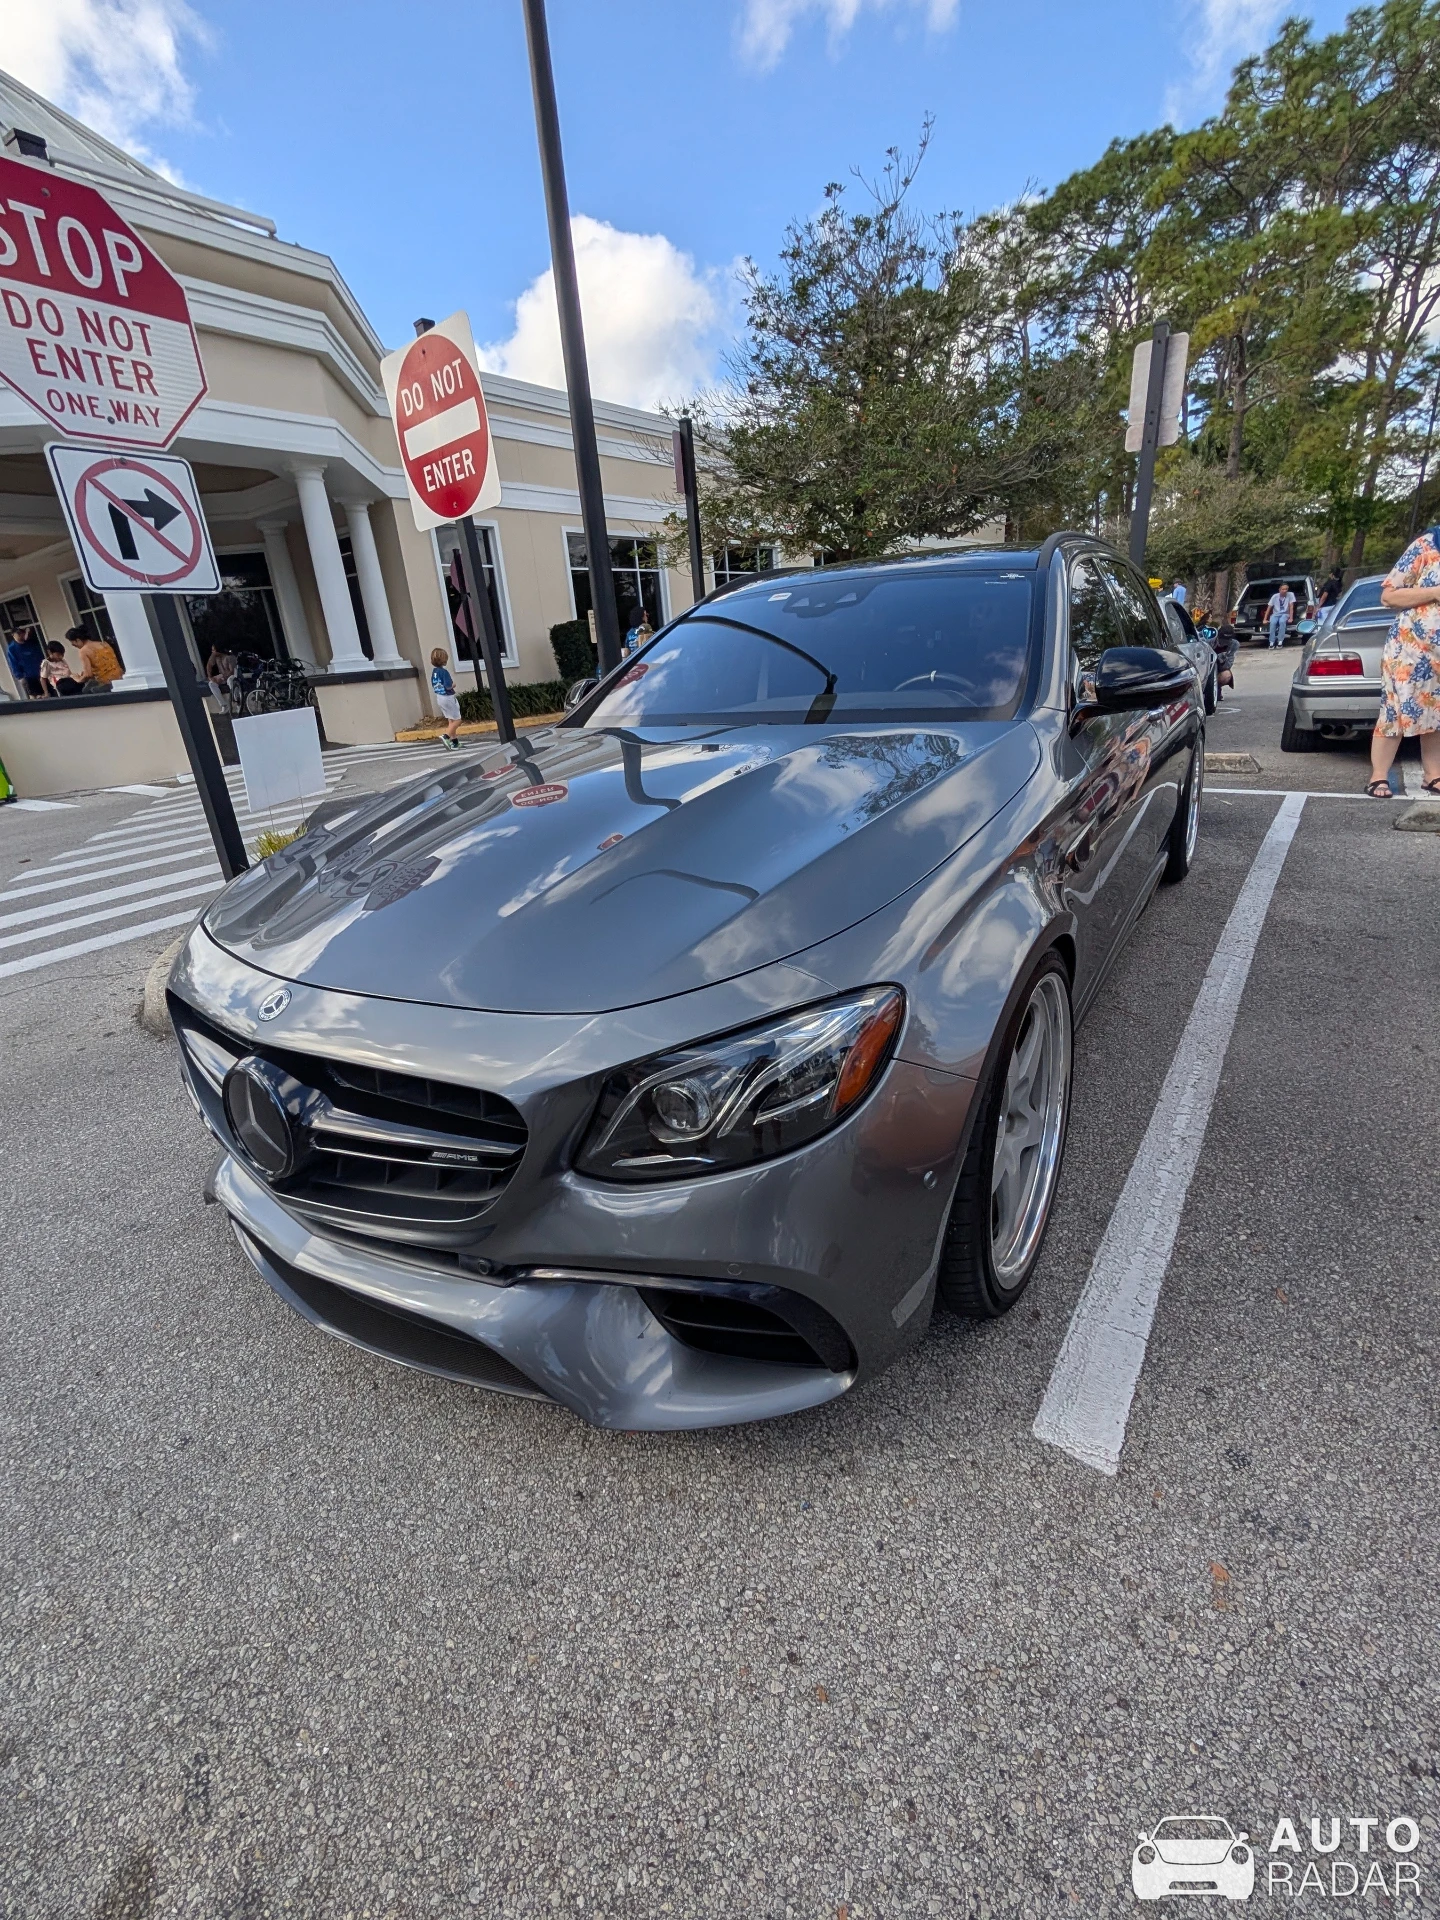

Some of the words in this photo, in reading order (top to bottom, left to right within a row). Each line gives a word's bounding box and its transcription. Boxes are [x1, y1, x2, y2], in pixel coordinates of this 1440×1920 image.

[1, 288, 65, 337] DO
[76, 307, 152, 357] NOT
[26, 337, 160, 397] ENTER
[400, 381, 424, 417] DO
[430, 358, 464, 401] NOT
[46, 388, 106, 420] ONE
[108, 399, 160, 428] WAY
[423, 448, 476, 492] ENTER
[446, 1152, 479, 1162] AMG
